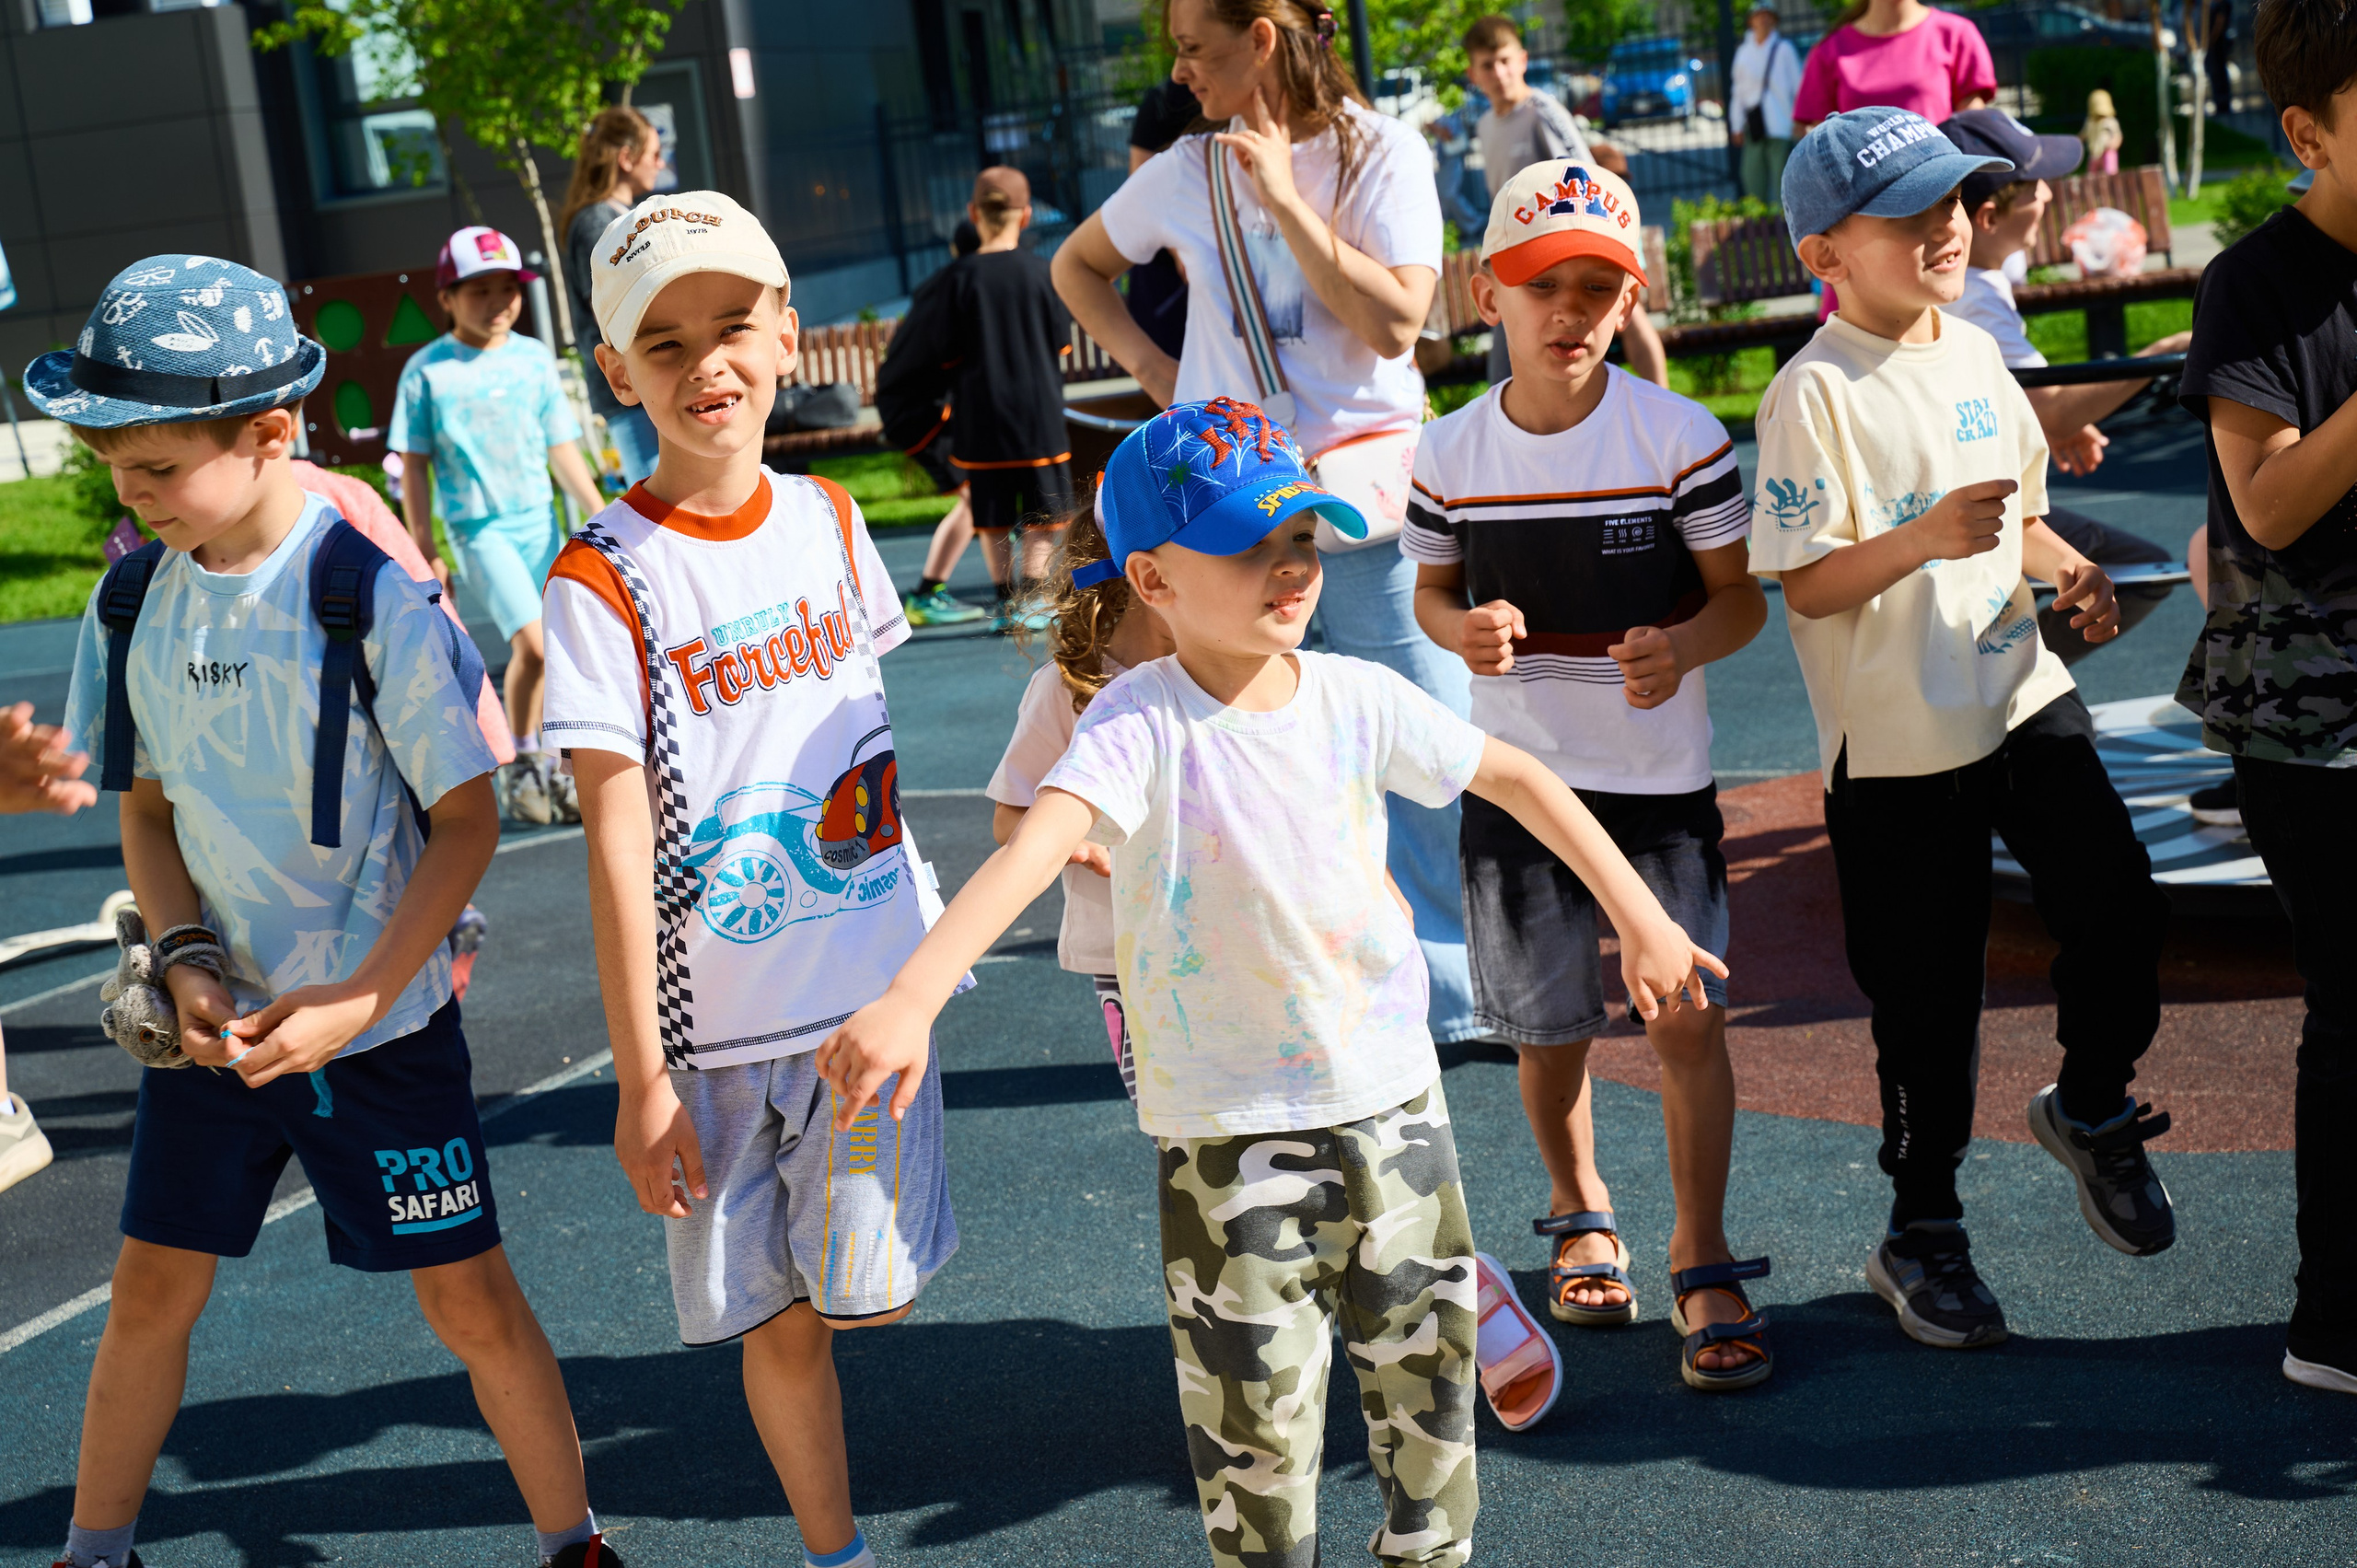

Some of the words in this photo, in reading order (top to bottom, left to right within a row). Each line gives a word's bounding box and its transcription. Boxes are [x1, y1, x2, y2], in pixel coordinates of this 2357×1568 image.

[1866, 114, 1906, 137] WORLD
[1514, 179, 1631, 228] CAMPUS
[1956, 397, 1990, 429] STAY
[1956, 411, 1998, 442] CRAZY
[1620, 516, 1653, 525] ELEMENTS
[711, 601, 790, 647] UNRULY
[188, 661, 249, 692] RISKY
[1897, 1084, 1908, 1115] EASY
[1898, 1130, 1911, 1159] TAKE
[374, 1136, 474, 1193] PRO
[388, 1180, 480, 1223] SAFARI
